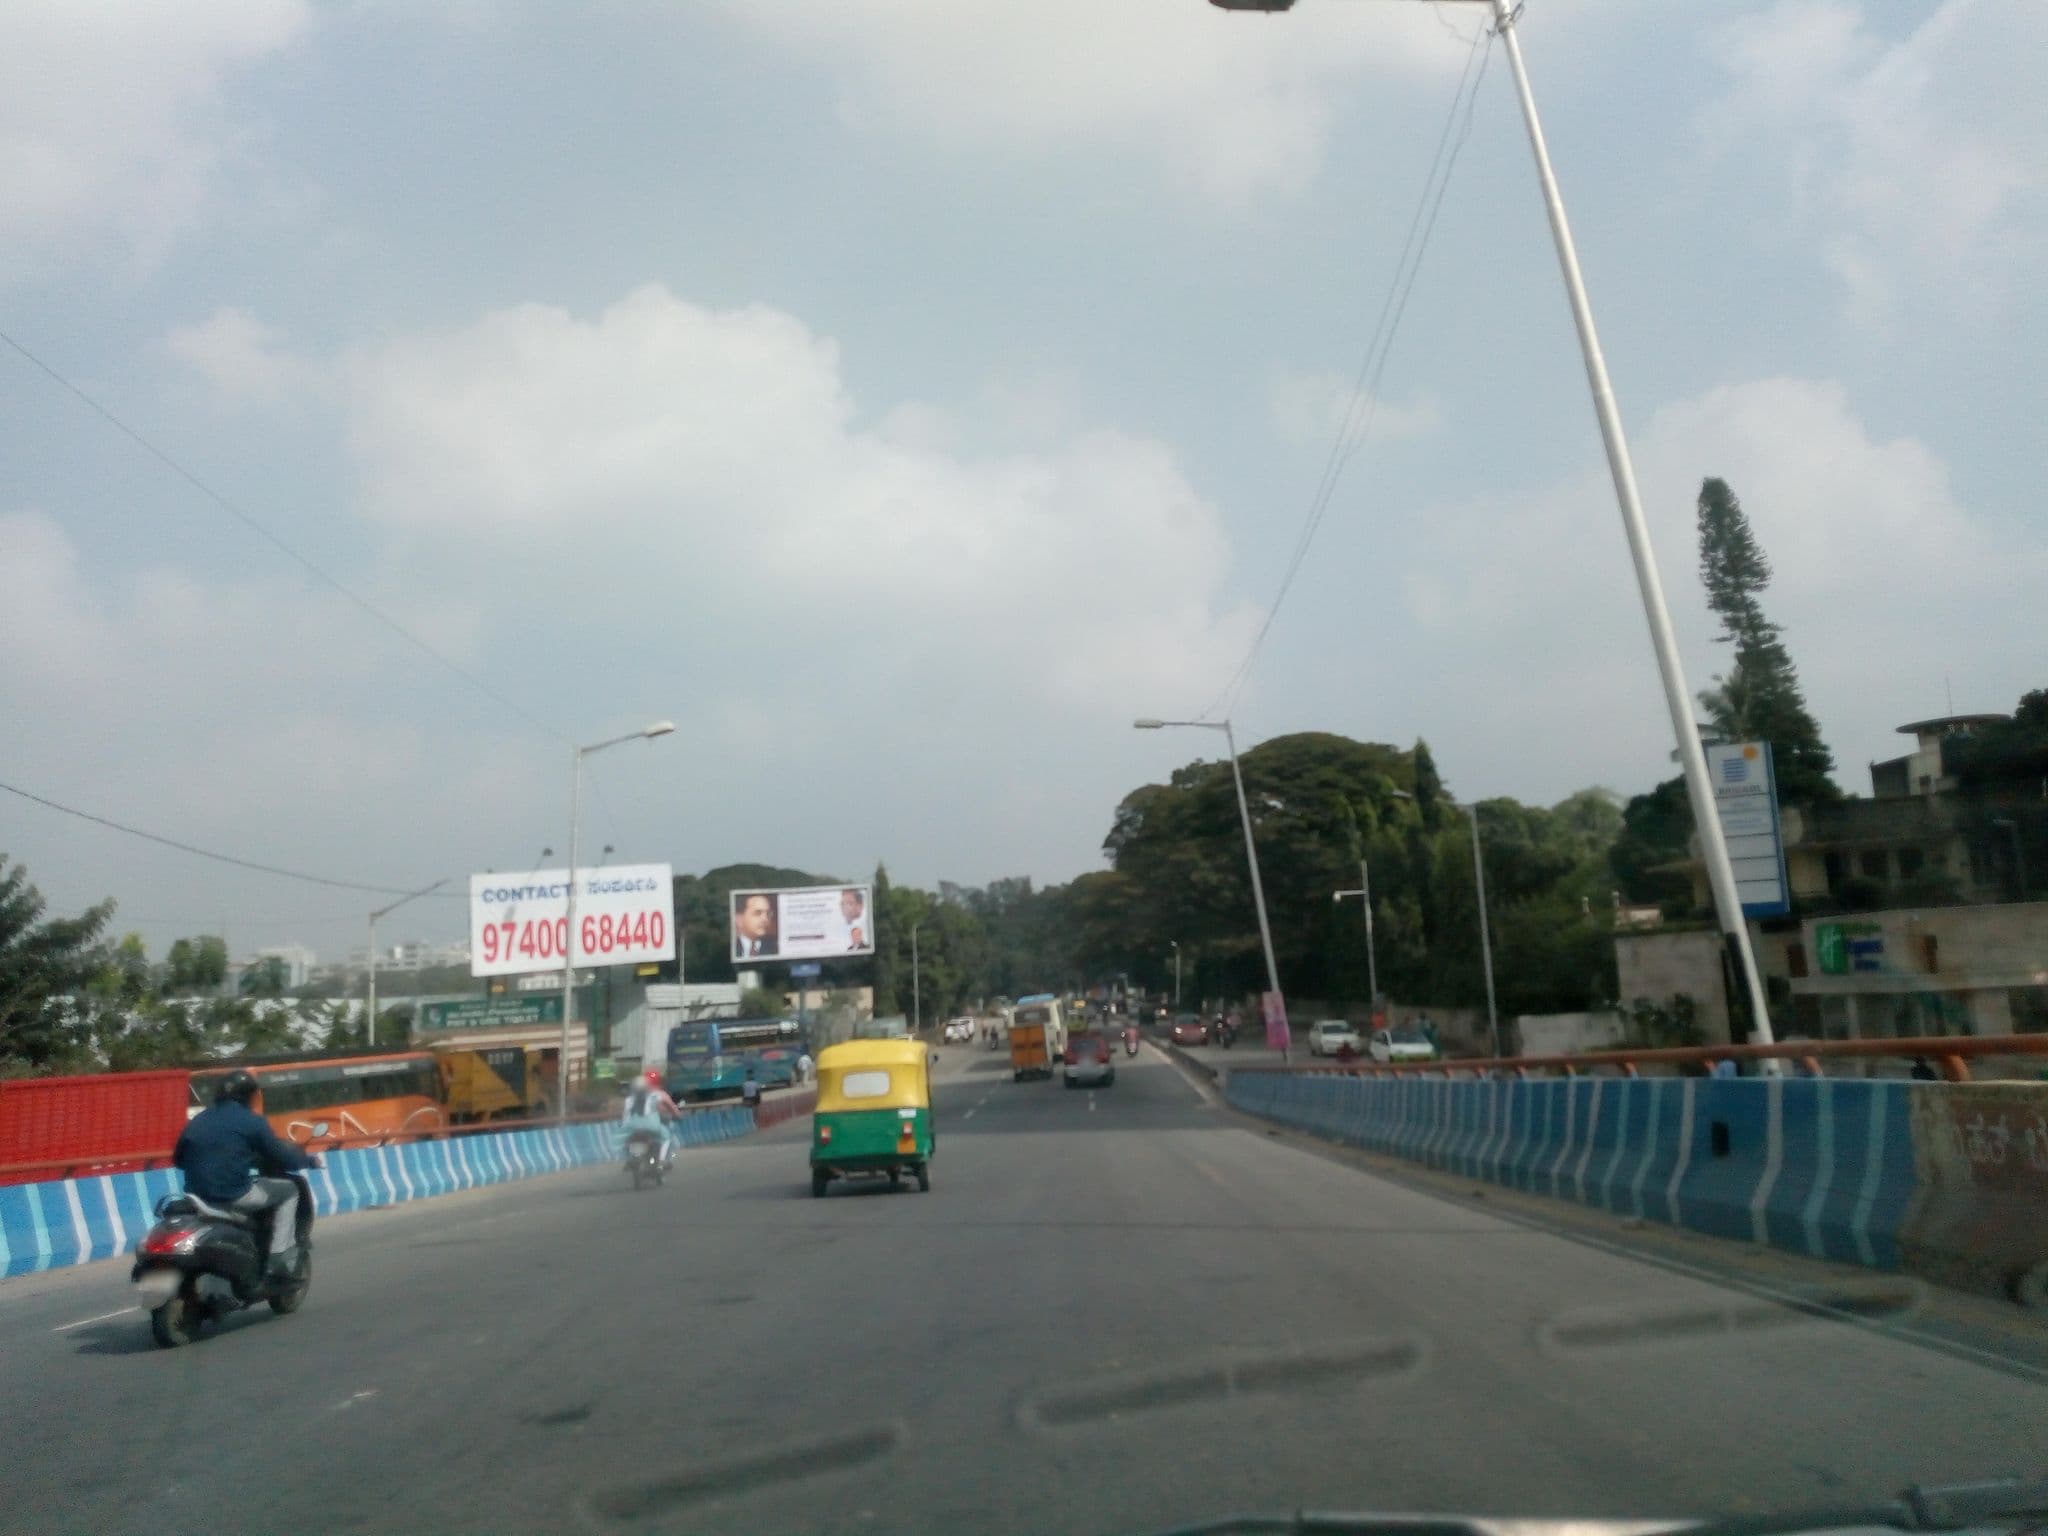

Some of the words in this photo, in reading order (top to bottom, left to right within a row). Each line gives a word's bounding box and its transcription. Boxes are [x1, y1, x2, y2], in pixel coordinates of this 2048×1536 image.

[482, 884, 573, 903] CONTACT
[483, 917, 570, 963] 97400
[582, 911, 664, 953] 68440
